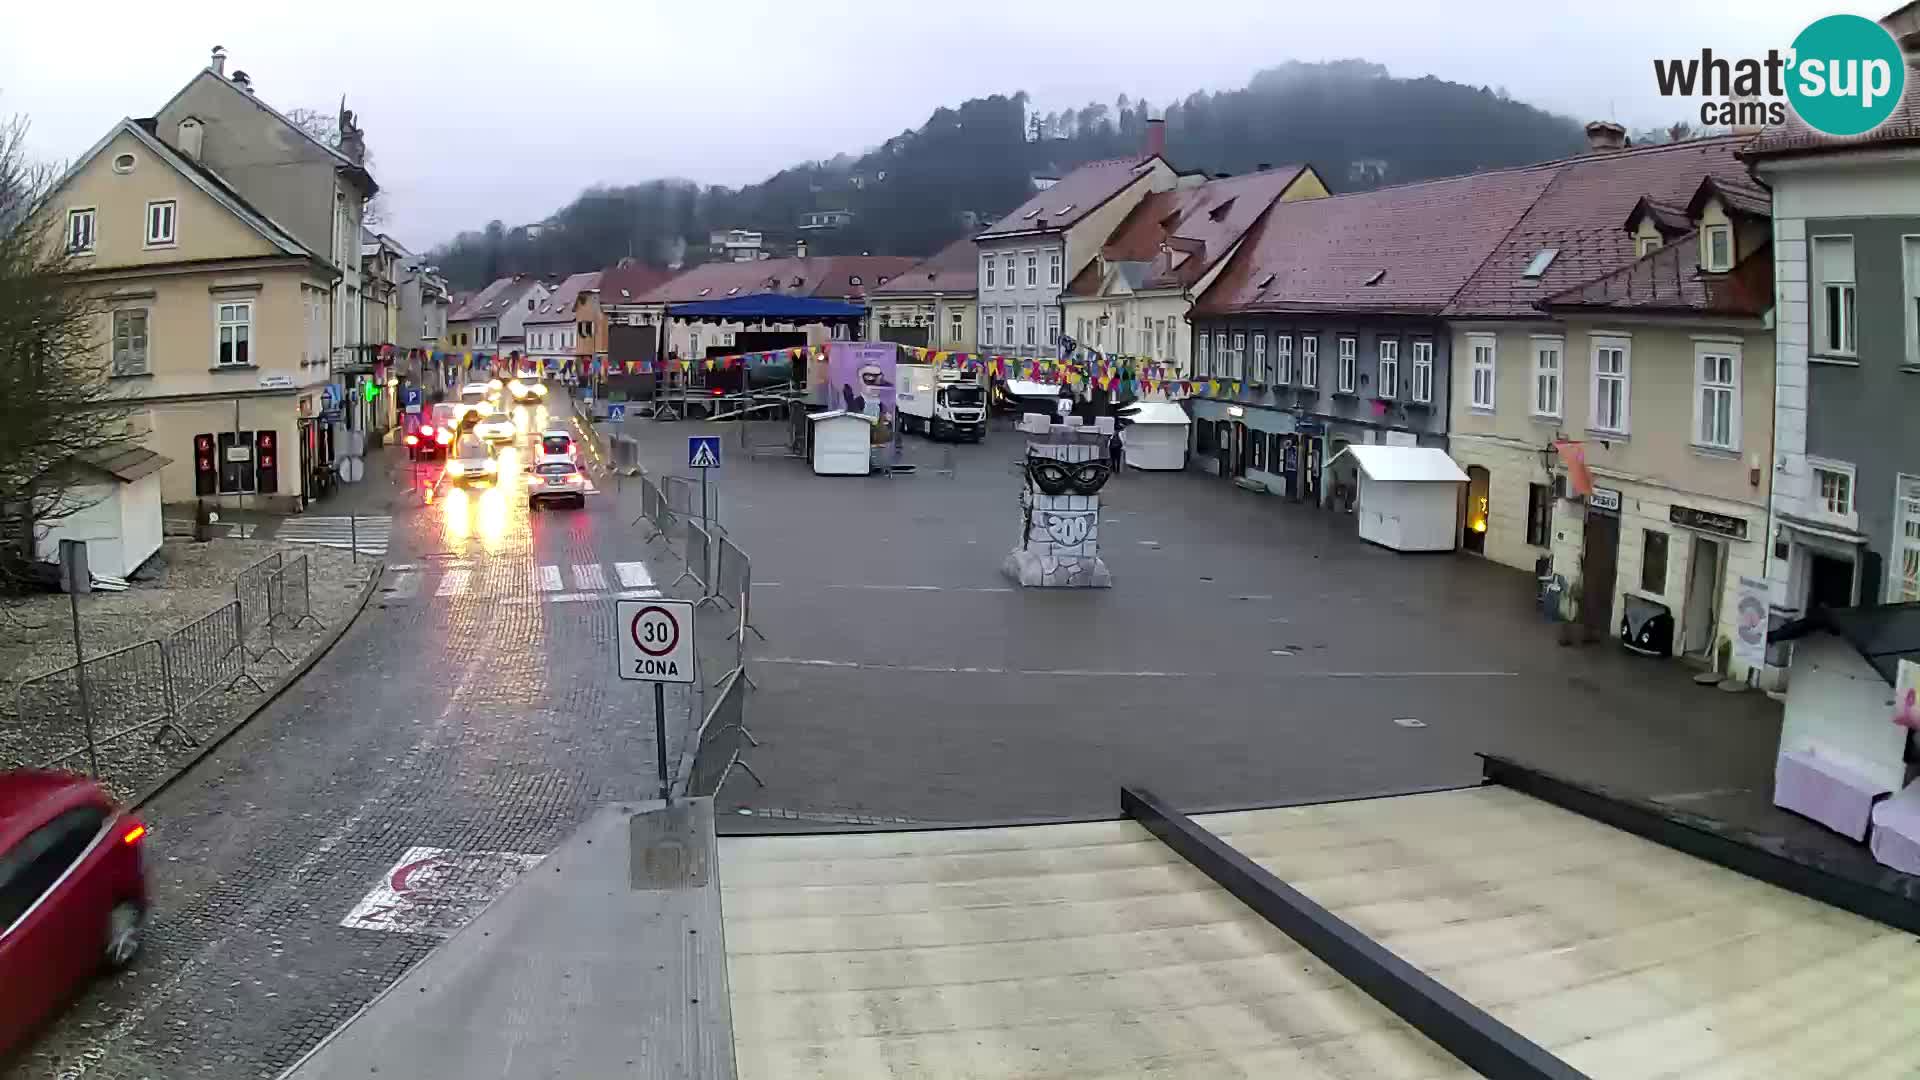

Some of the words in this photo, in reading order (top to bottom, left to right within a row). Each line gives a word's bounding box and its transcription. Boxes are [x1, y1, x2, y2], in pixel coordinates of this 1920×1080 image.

[1048, 516, 1088, 545] 200
[644, 622, 668, 642] 30
[634, 659, 679, 675] ZONA
